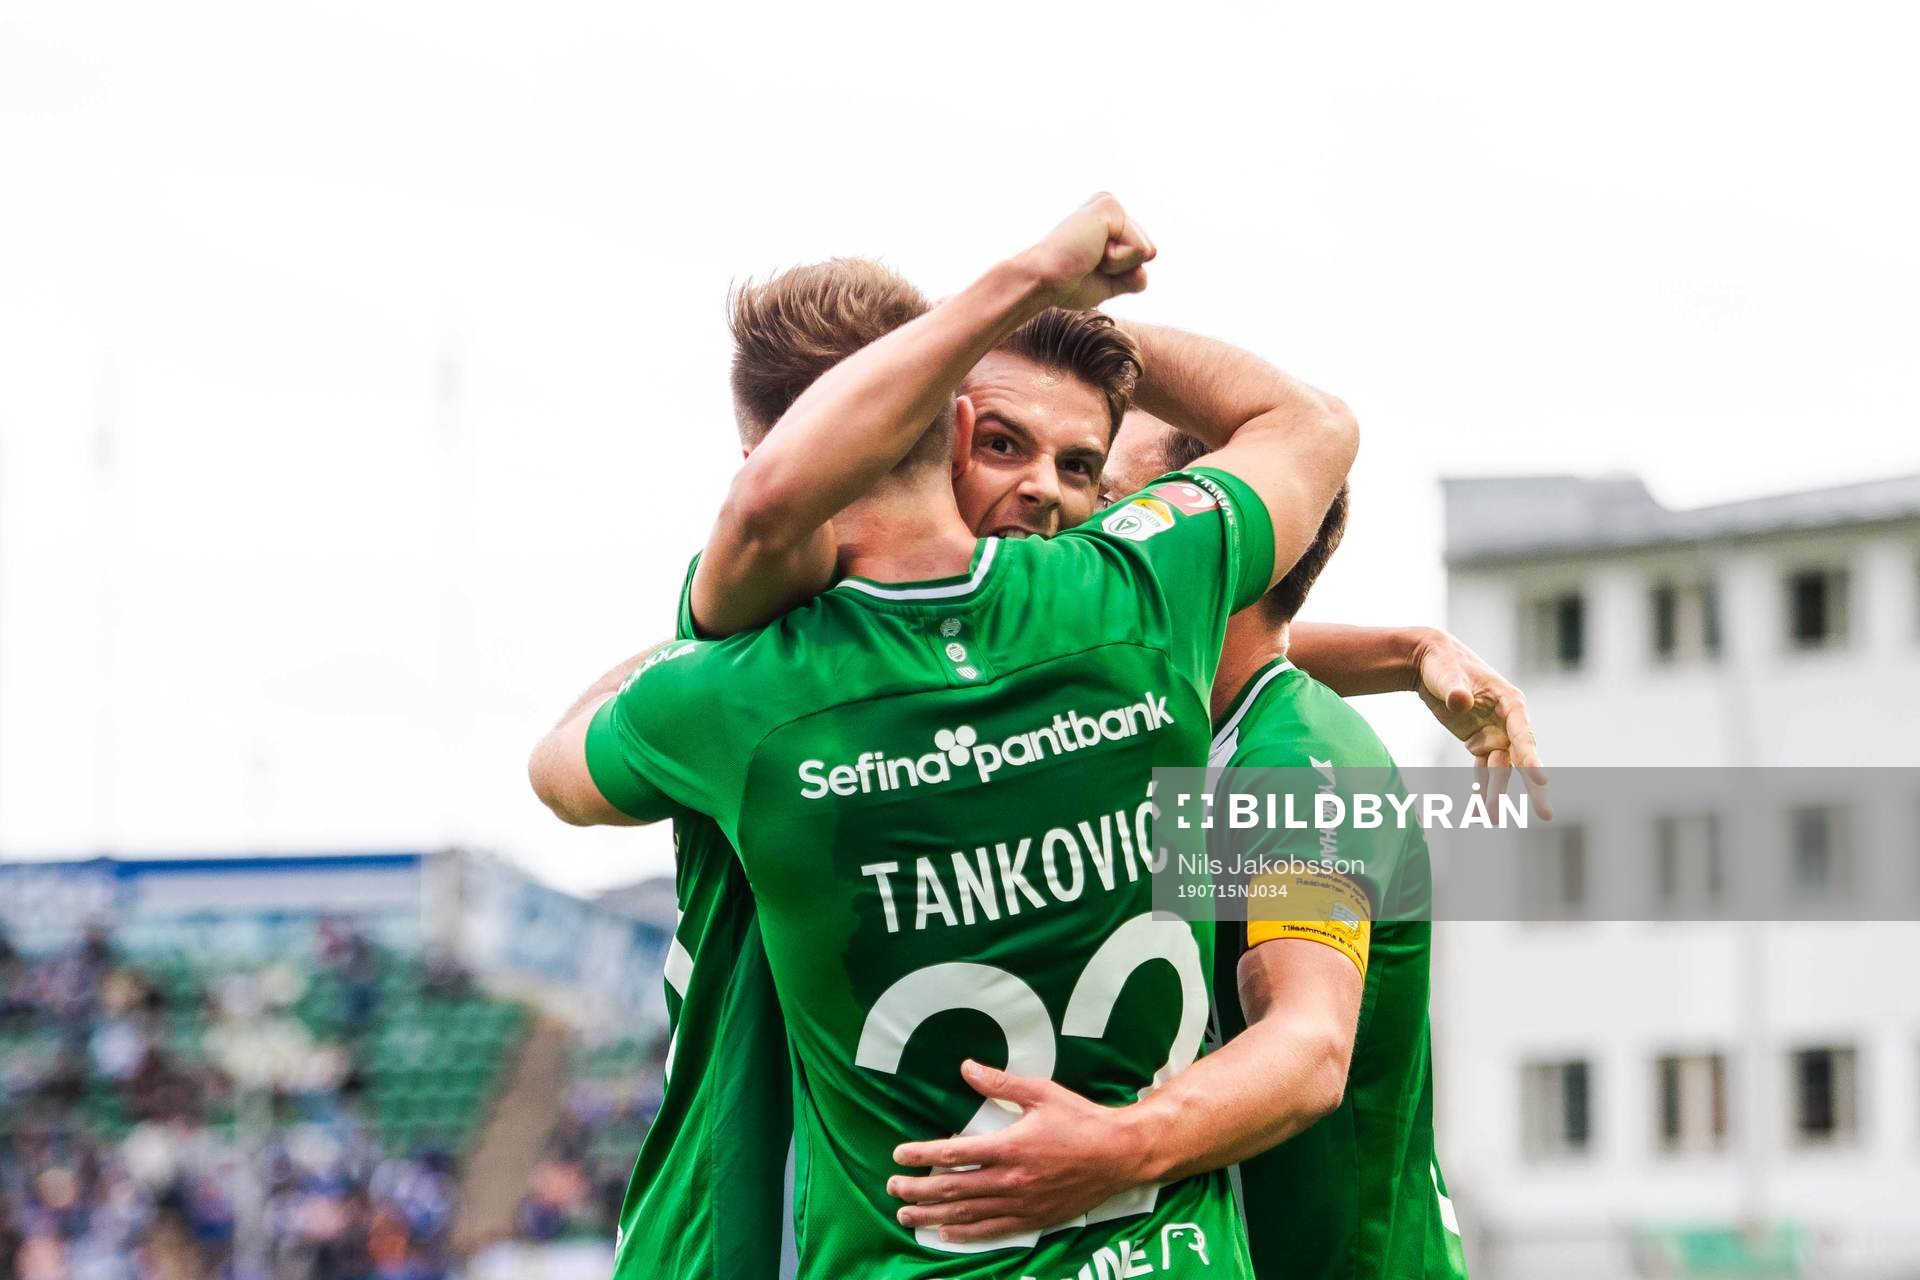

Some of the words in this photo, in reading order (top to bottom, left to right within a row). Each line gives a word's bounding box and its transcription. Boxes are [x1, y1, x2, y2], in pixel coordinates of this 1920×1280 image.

[799, 751, 951, 799] Sefina
[972, 692, 1174, 782] pantbank
[861, 781, 1168, 933] TANKOVIĆ
[855, 911, 1208, 1253] 22
